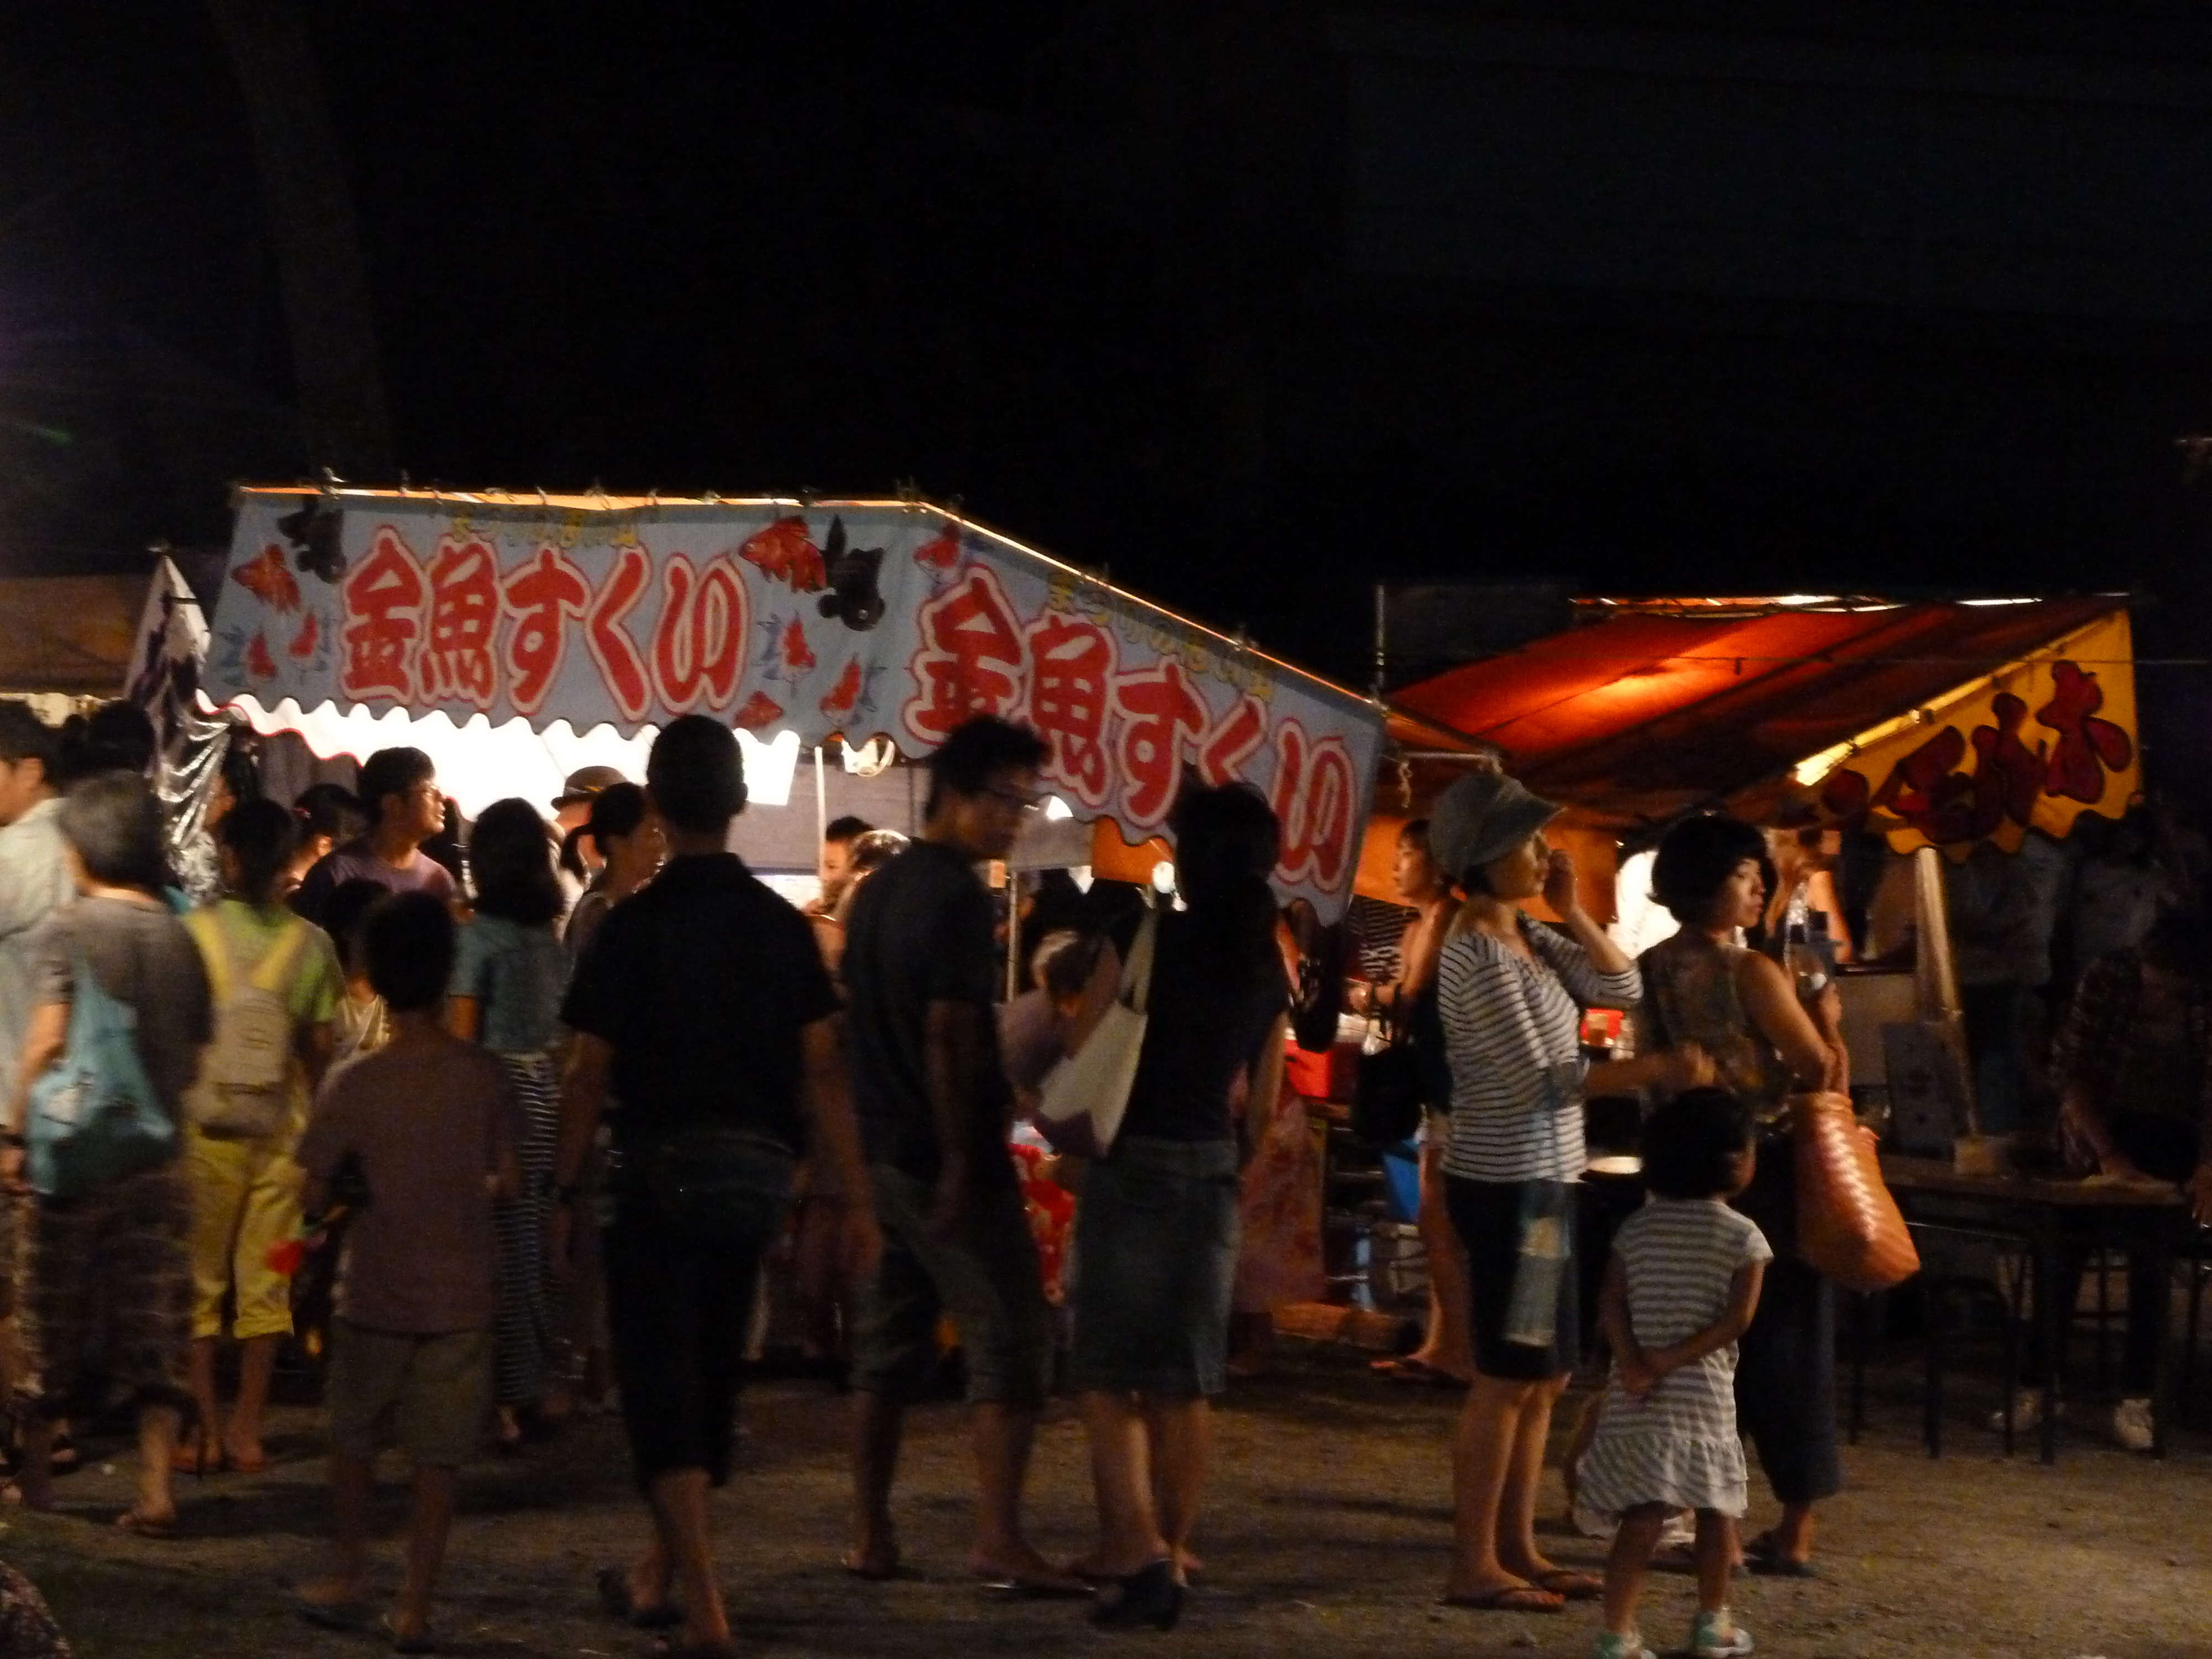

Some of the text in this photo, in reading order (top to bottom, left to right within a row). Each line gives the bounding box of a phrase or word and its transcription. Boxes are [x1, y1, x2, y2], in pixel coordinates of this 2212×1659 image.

[341, 524, 749, 721] 金魚すくい
